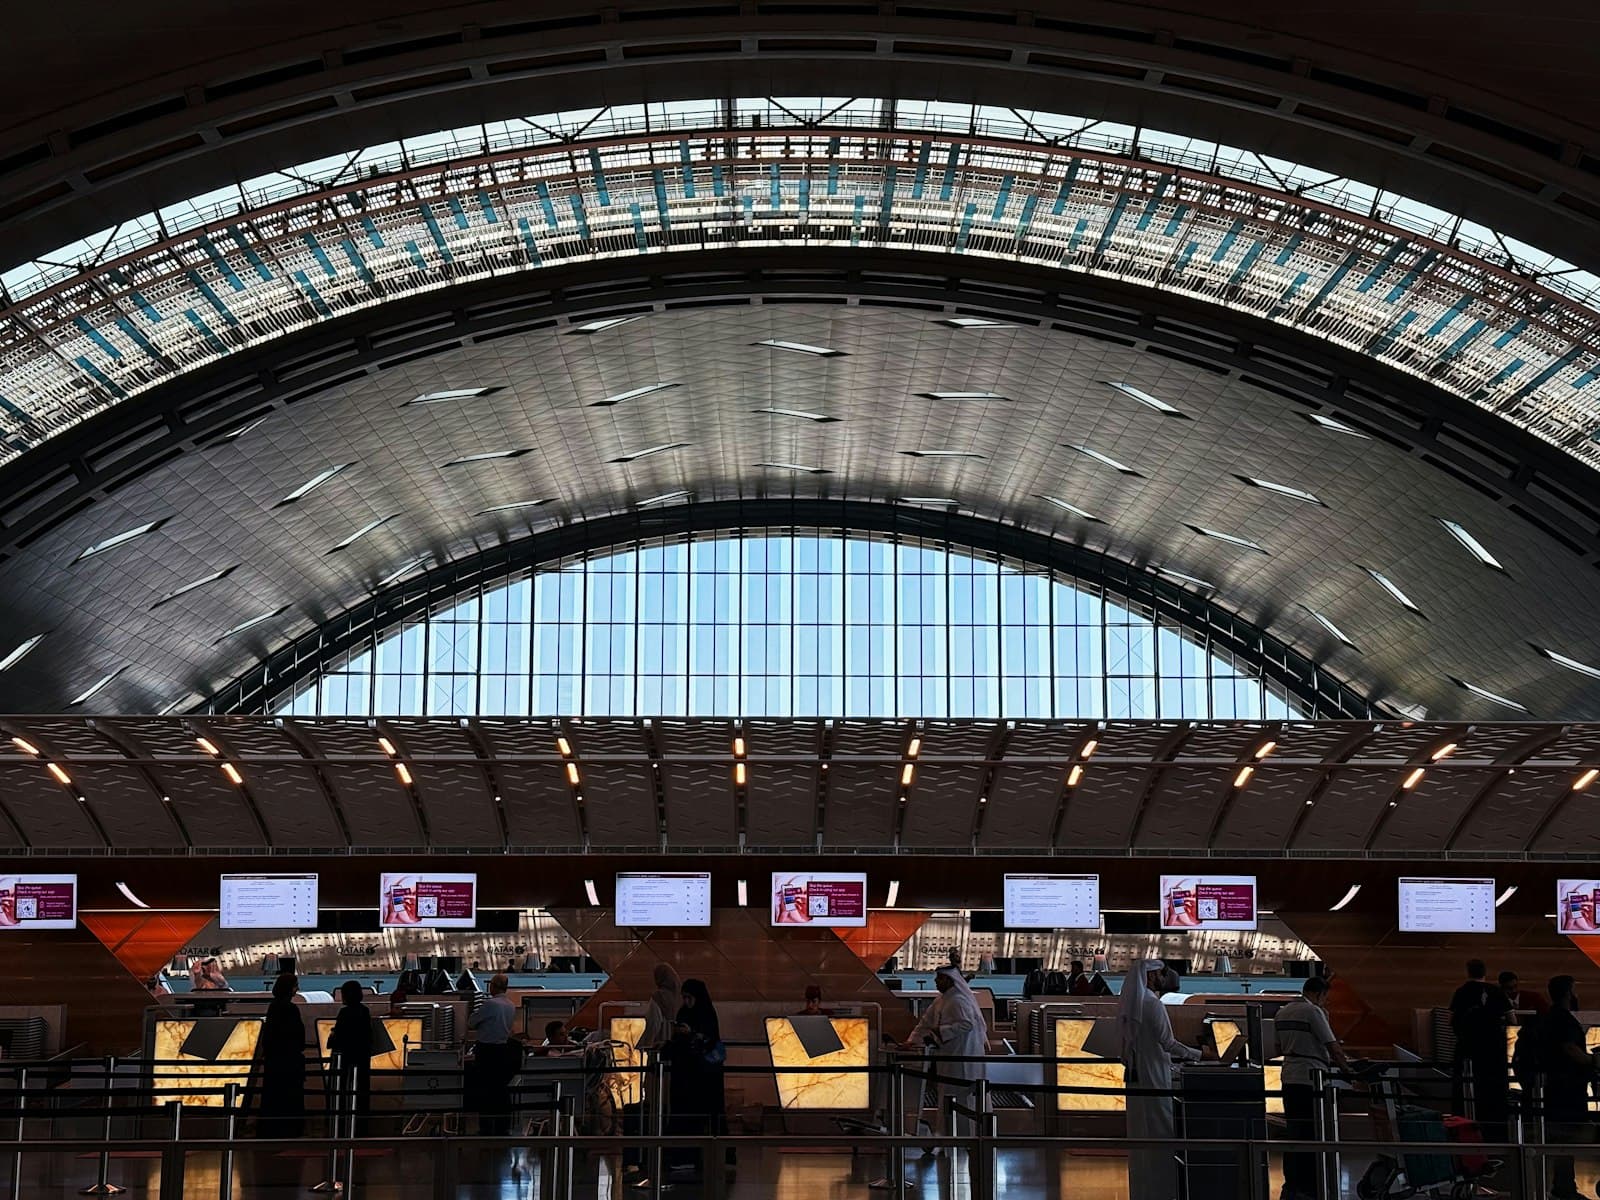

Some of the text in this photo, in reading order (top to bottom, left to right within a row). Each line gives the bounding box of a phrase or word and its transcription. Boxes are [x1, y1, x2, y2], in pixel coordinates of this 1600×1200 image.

[336, 946, 365, 954] QATAR
[487, 946, 514, 954] QATAR
[921, 946, 948, 954] QATAR
[1066, 947, 1094, 955] QATAR
[1215, 948, 1244, 956] QATAR
